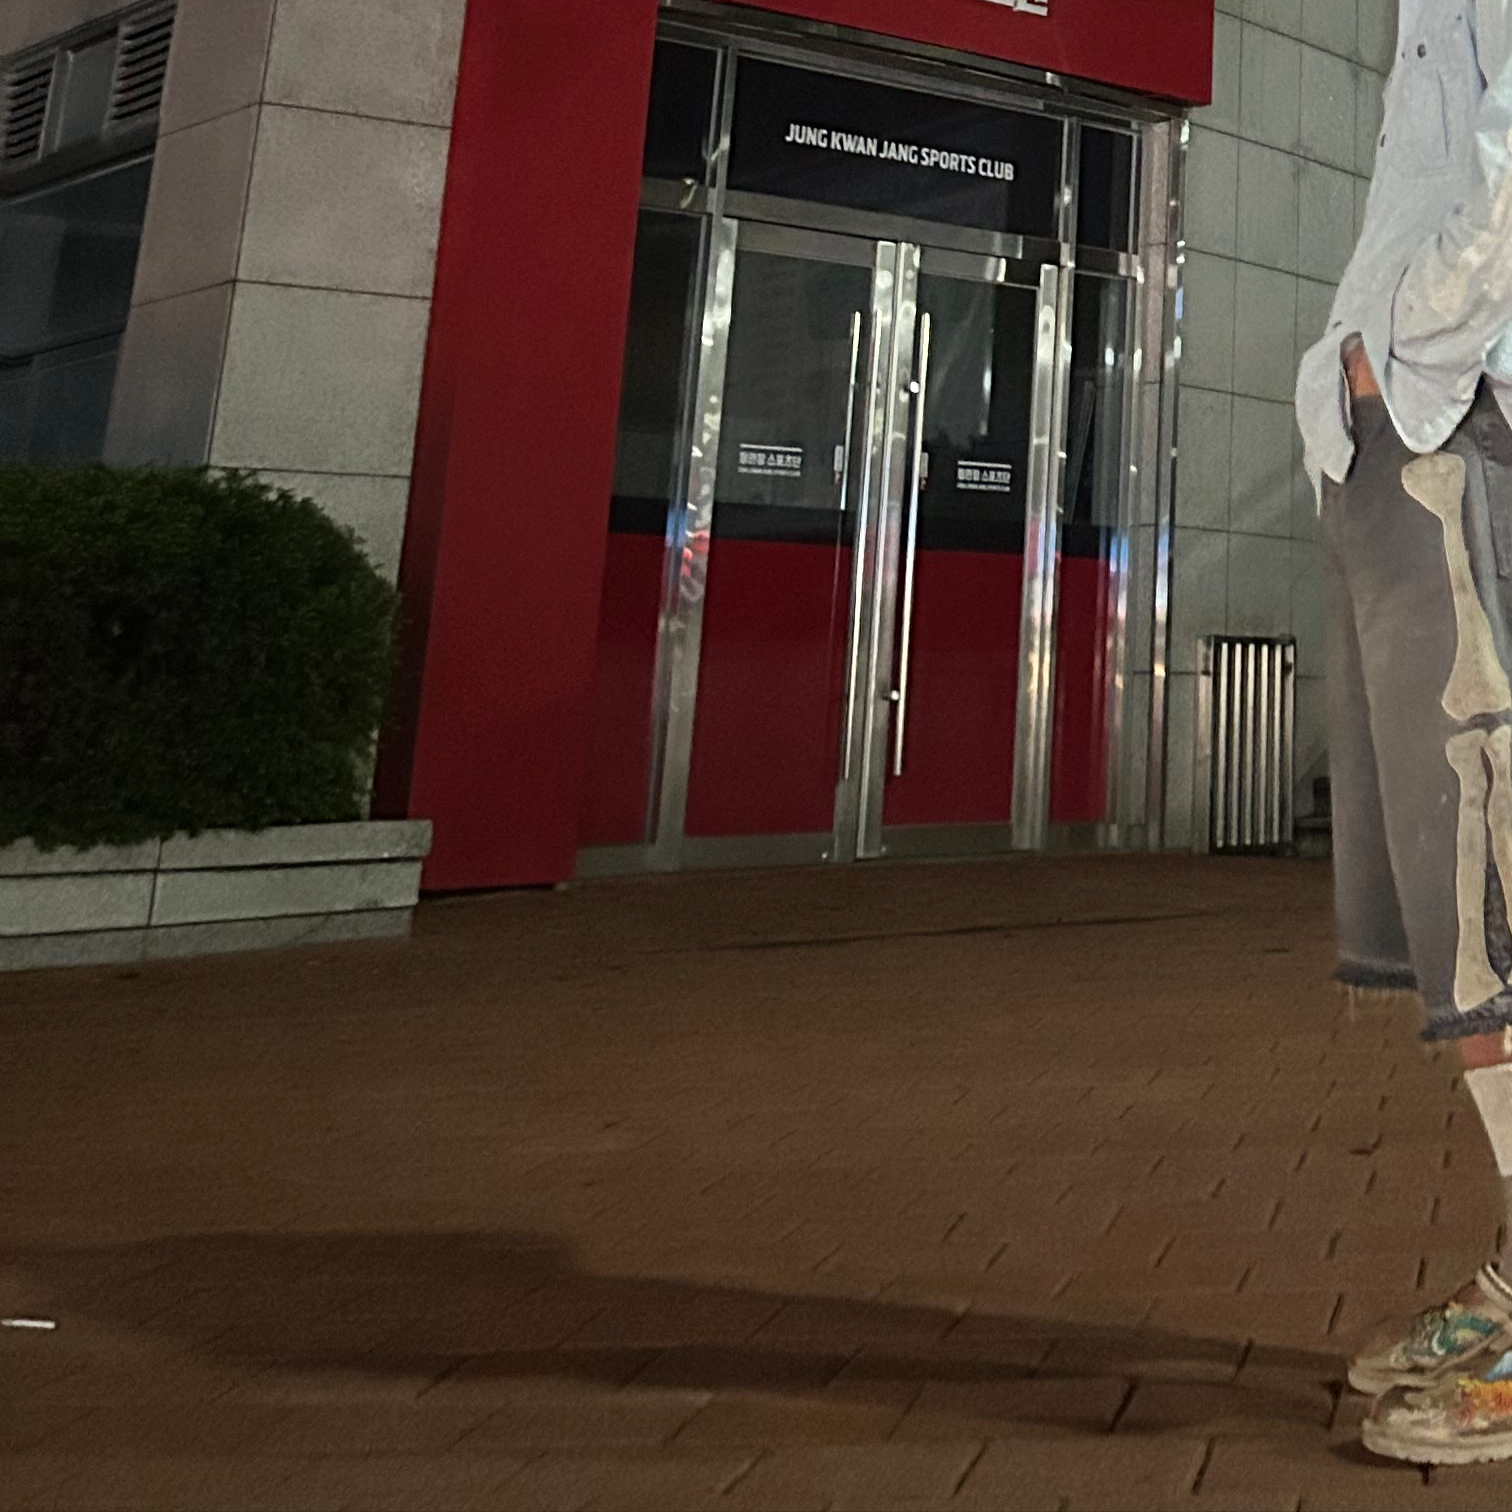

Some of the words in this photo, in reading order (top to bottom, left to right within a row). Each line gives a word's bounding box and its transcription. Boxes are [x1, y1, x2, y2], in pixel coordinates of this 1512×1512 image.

[785, 123, 828, 148] JUNG
[830, 131, 877, 156] KWAN
[879, 141, 918, 165] JANG
[920, 147, 976, 174] SPORTS
[978, 159, 1015, 181] CLUB
